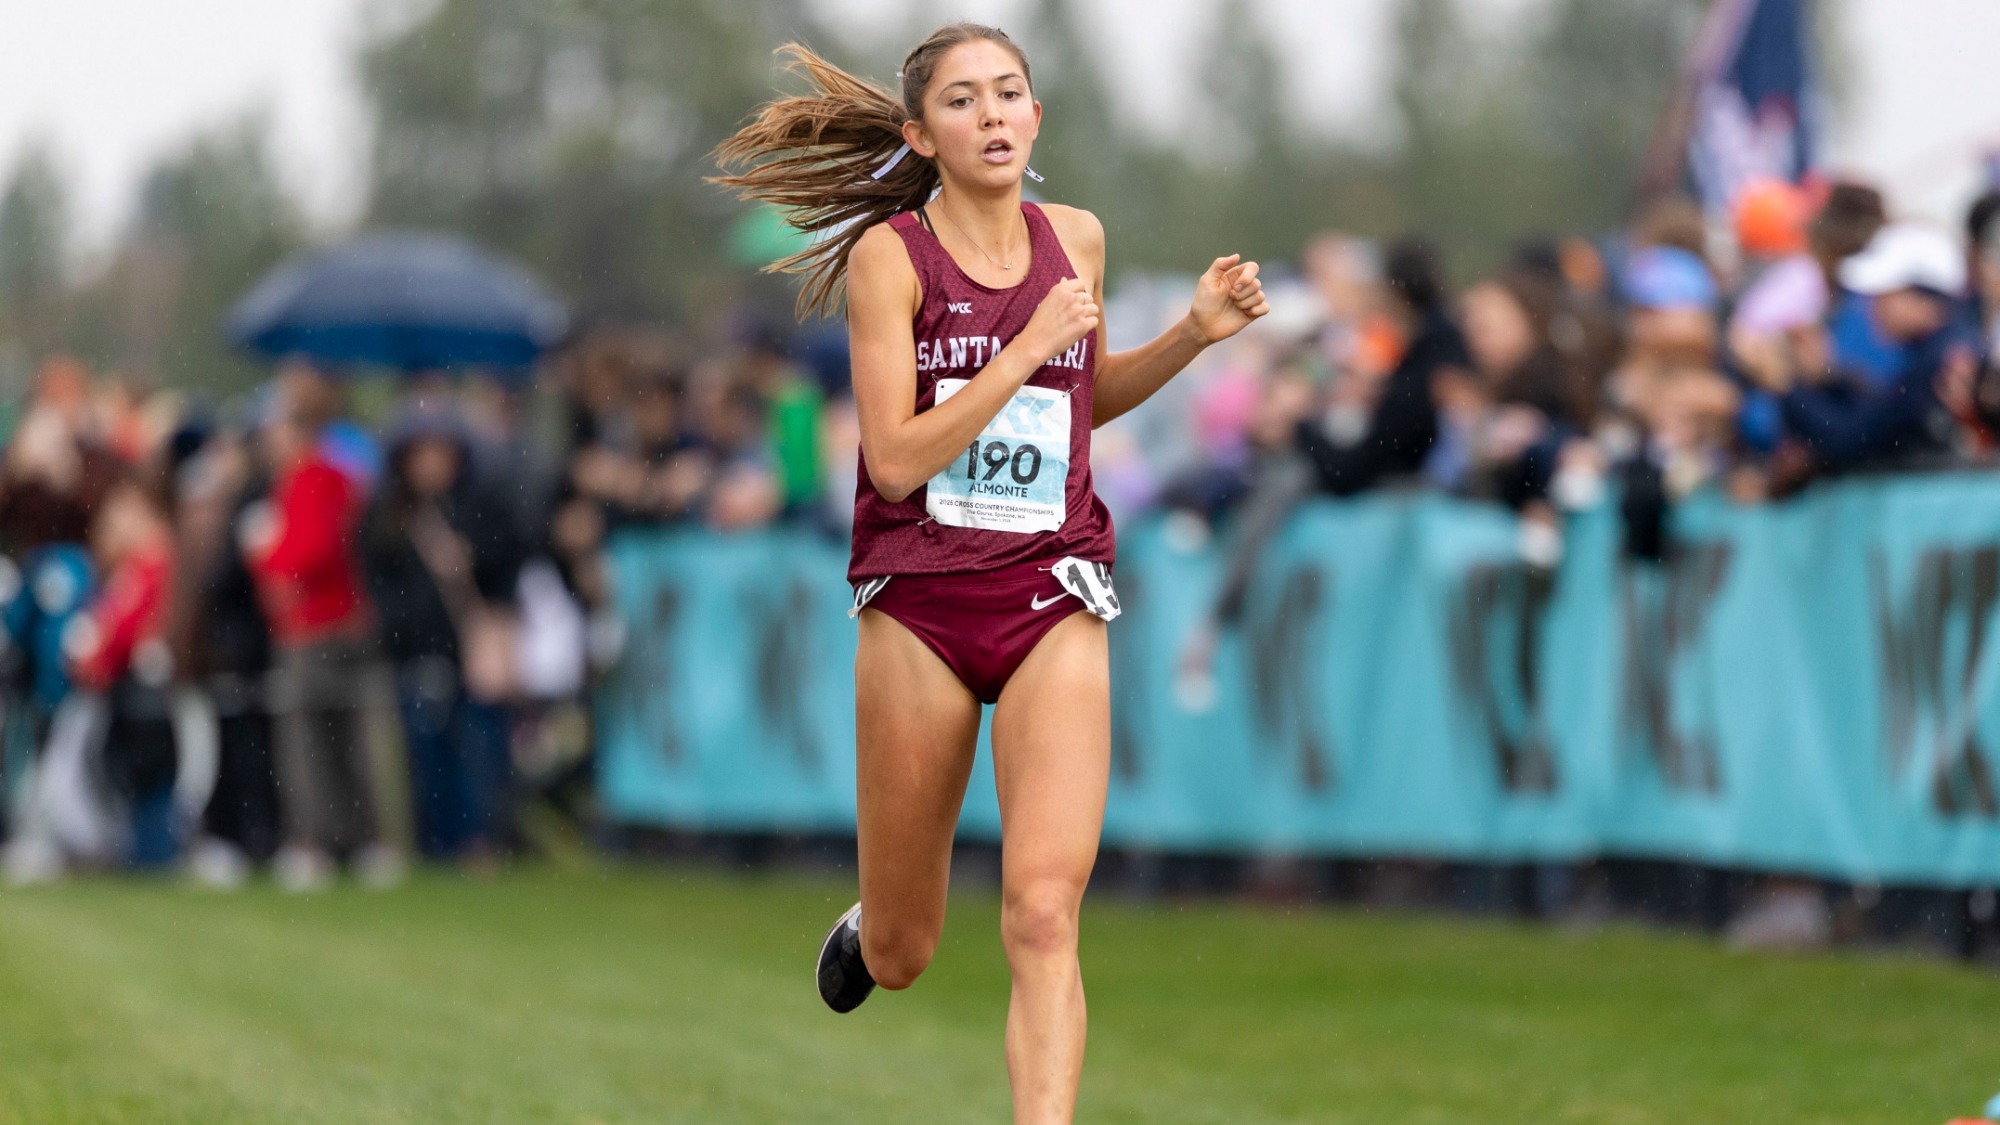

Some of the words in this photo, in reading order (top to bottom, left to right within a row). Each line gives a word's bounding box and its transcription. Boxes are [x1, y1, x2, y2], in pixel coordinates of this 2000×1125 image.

[947, 302, 972, 314] WCC
[917, 336, 1001, 371] SANTA
[967, 440, 1042, 485] 190
[969, 482, 1028, 498] ALMONTE
[954, 500, 974, 509] CROSS
[974, 502, 1005, 511] COUNTRY
[1005, 505, 1055, 516] CHAMPIONSHIPS
